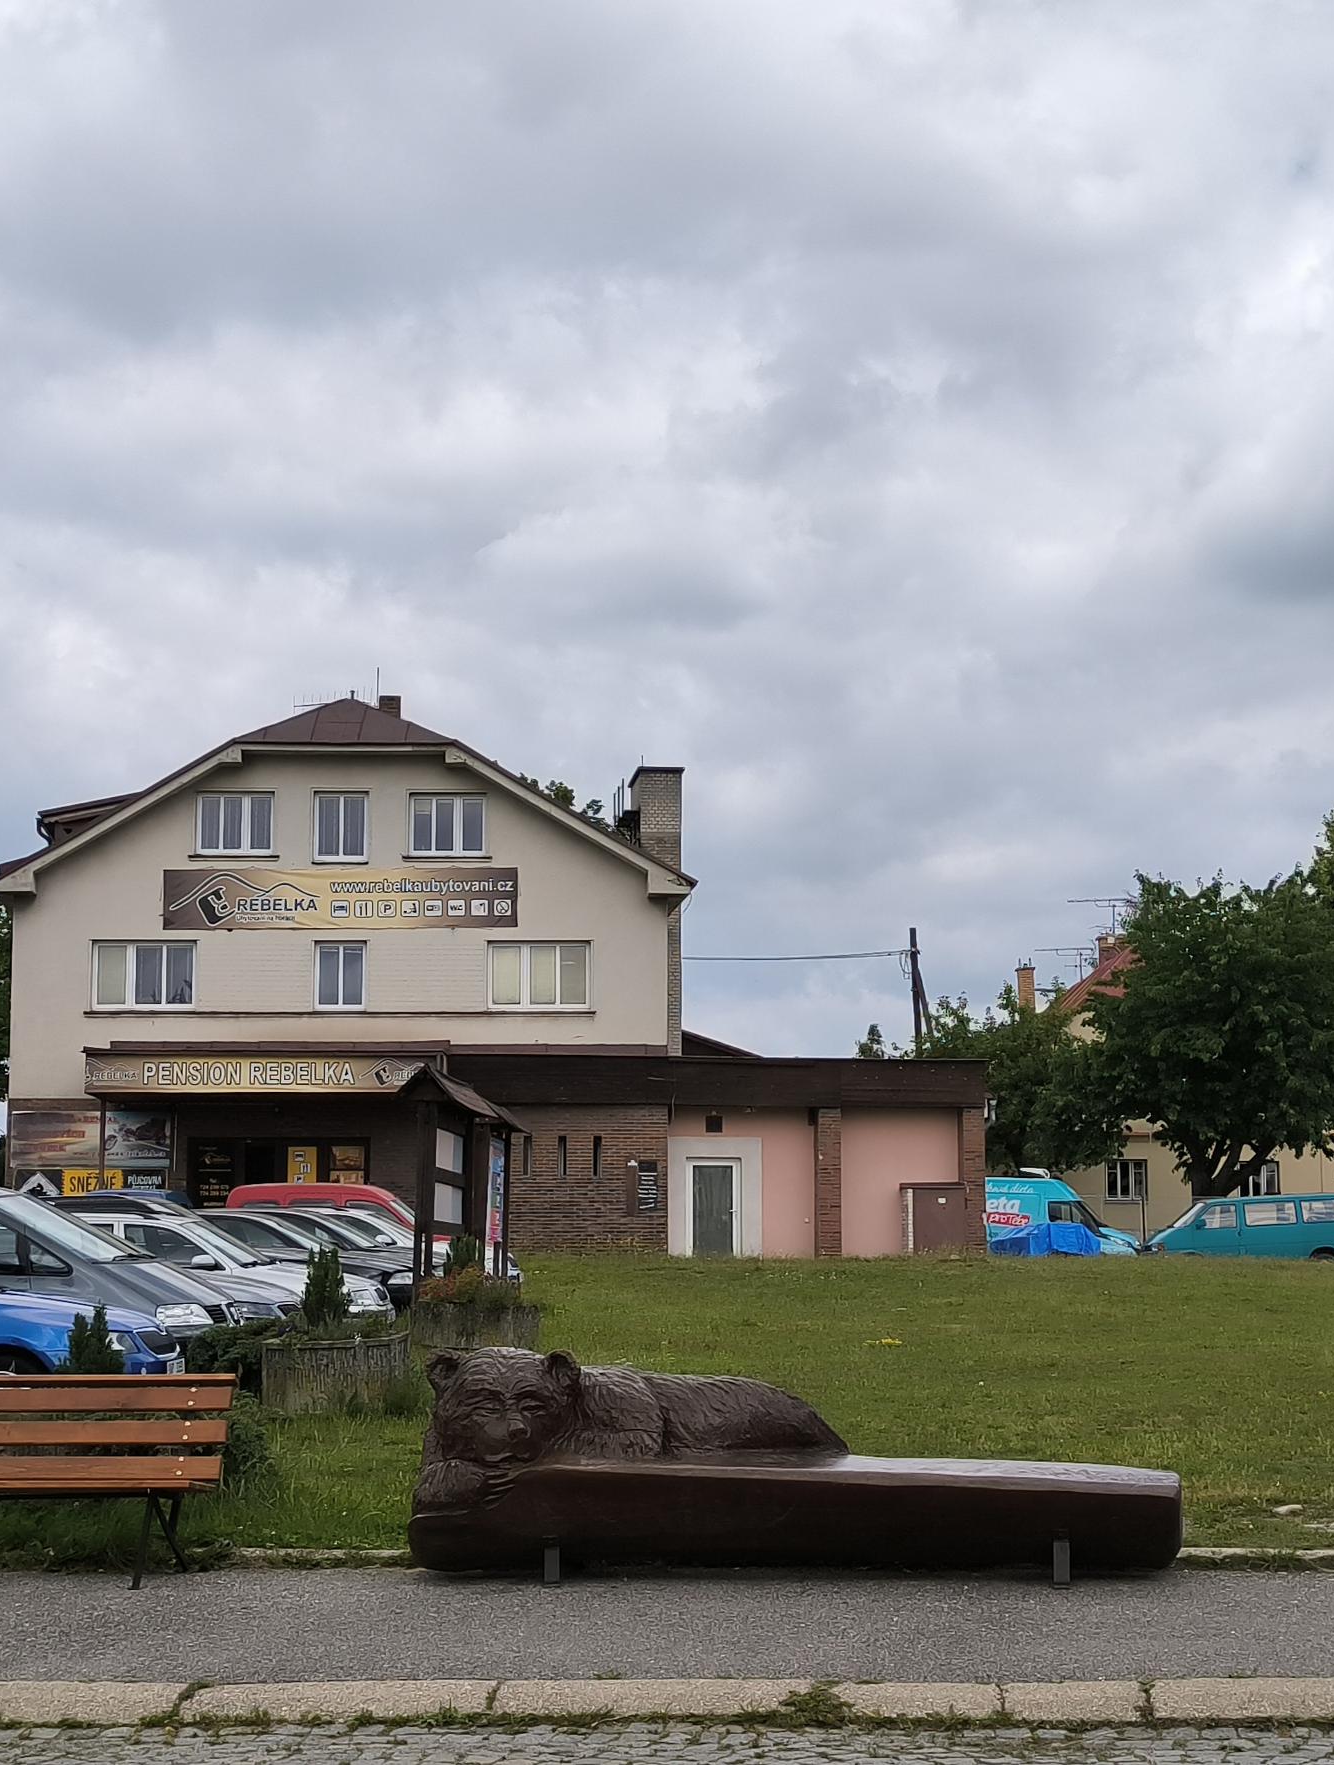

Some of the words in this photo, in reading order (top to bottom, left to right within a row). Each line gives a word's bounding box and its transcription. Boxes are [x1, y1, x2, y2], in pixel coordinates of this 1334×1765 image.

[330, 878, 515, 895] www.rebelkaubytovani.cz
[236, 898, 318, 912] REBELKA
[142, 1061, 242, 1086] PENSION
[248, 1061, 356, 1085] REBELKA
